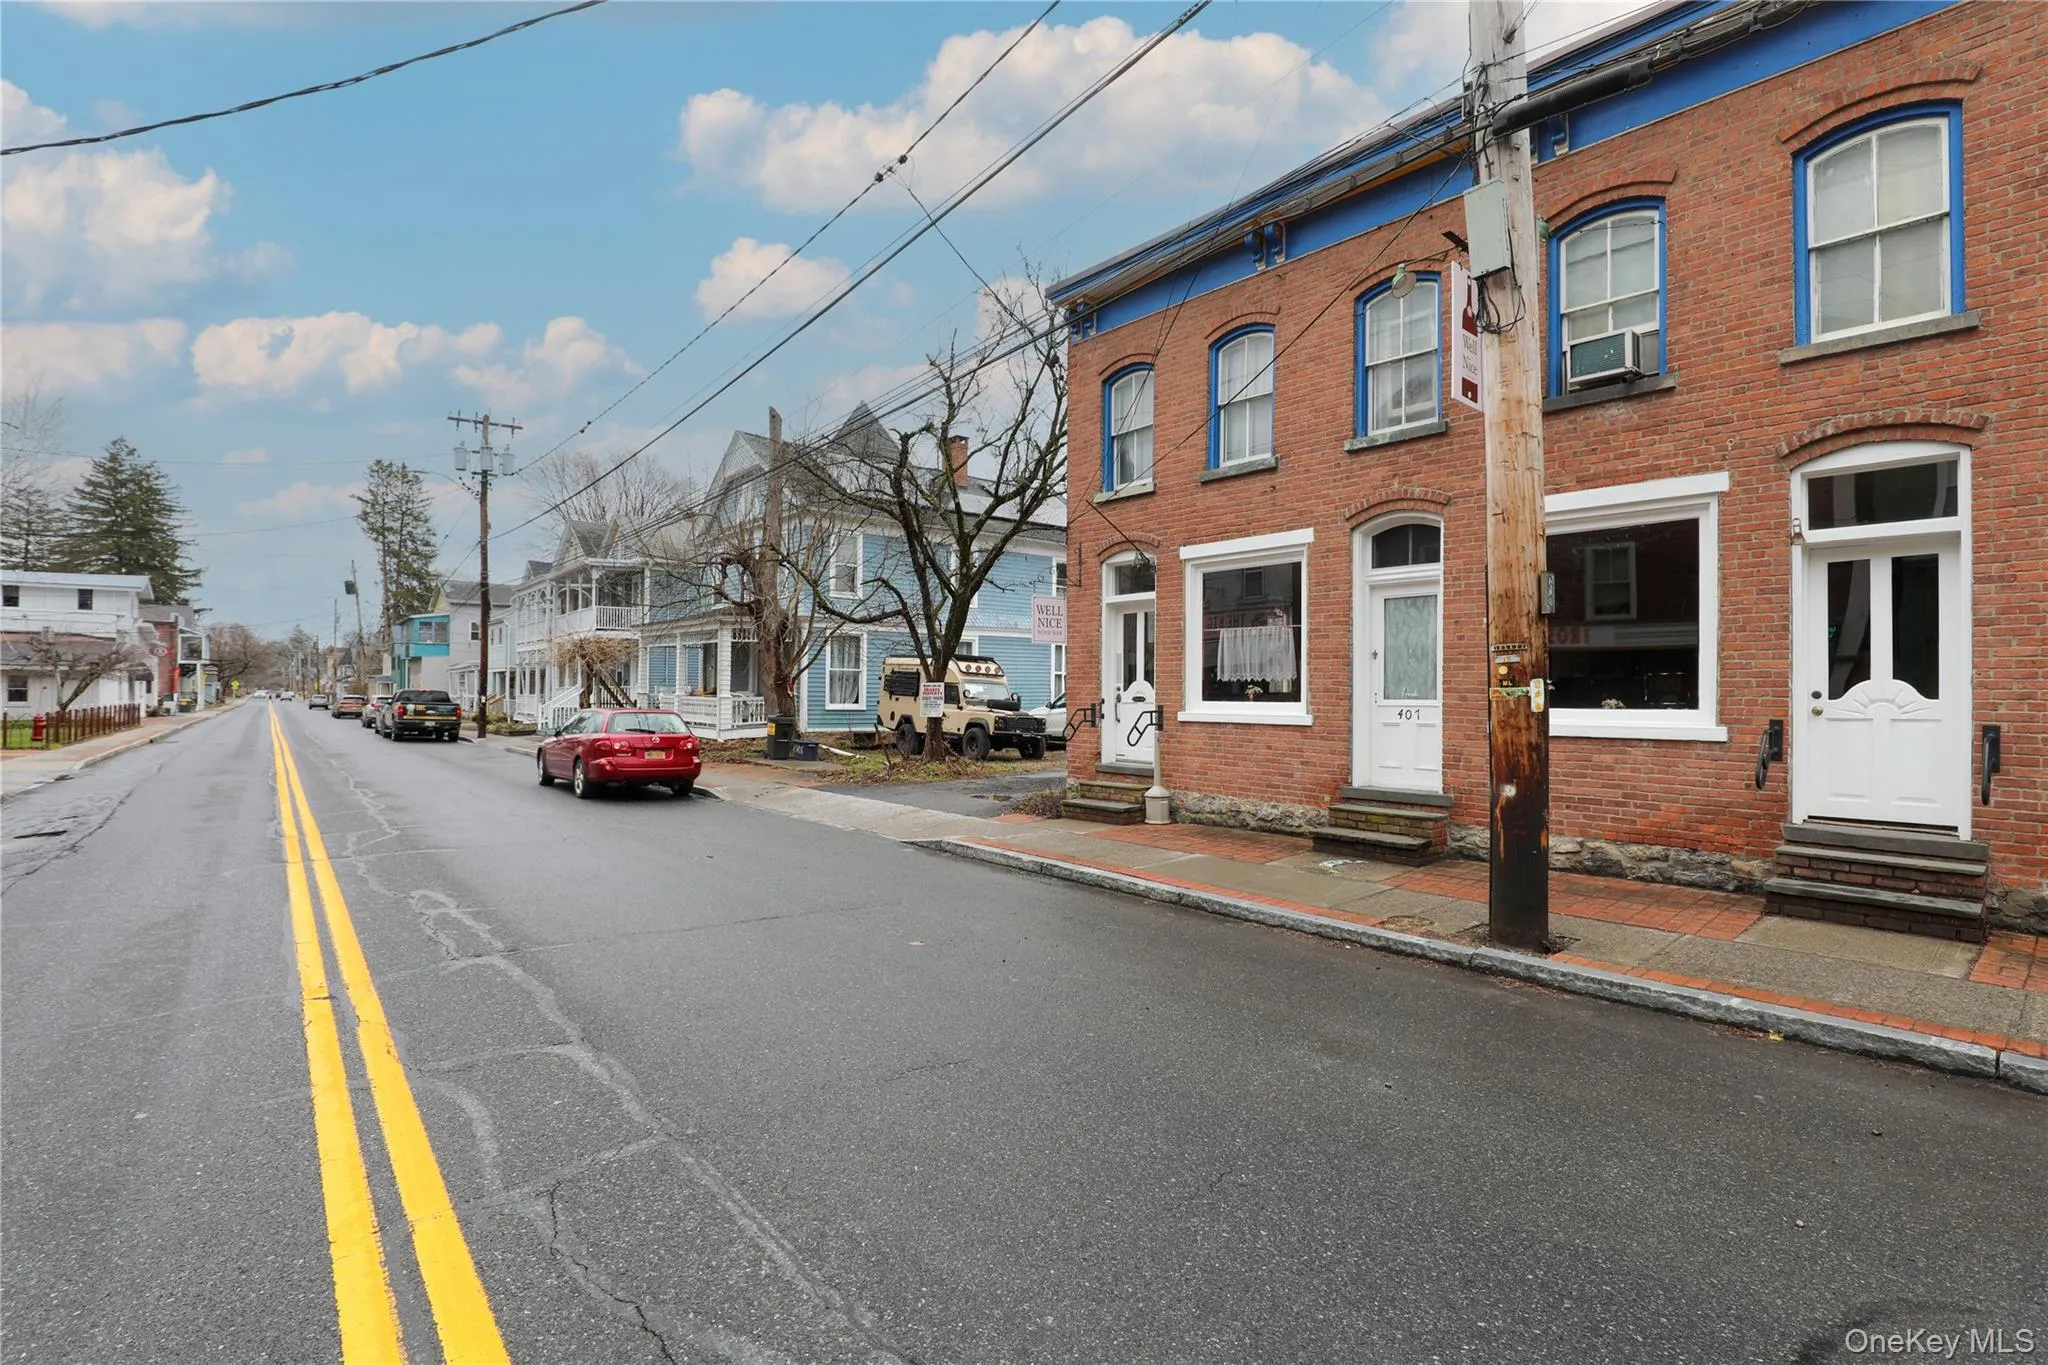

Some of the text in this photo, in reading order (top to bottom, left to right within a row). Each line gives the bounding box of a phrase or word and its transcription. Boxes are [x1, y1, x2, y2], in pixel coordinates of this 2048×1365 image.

[1462, 333, 1477, 355] Well
[1462, 353, 1477, 373] Nice
[1037, 604, 1064, 616] WELL
[1037, 617, 1062, 629] NICE
